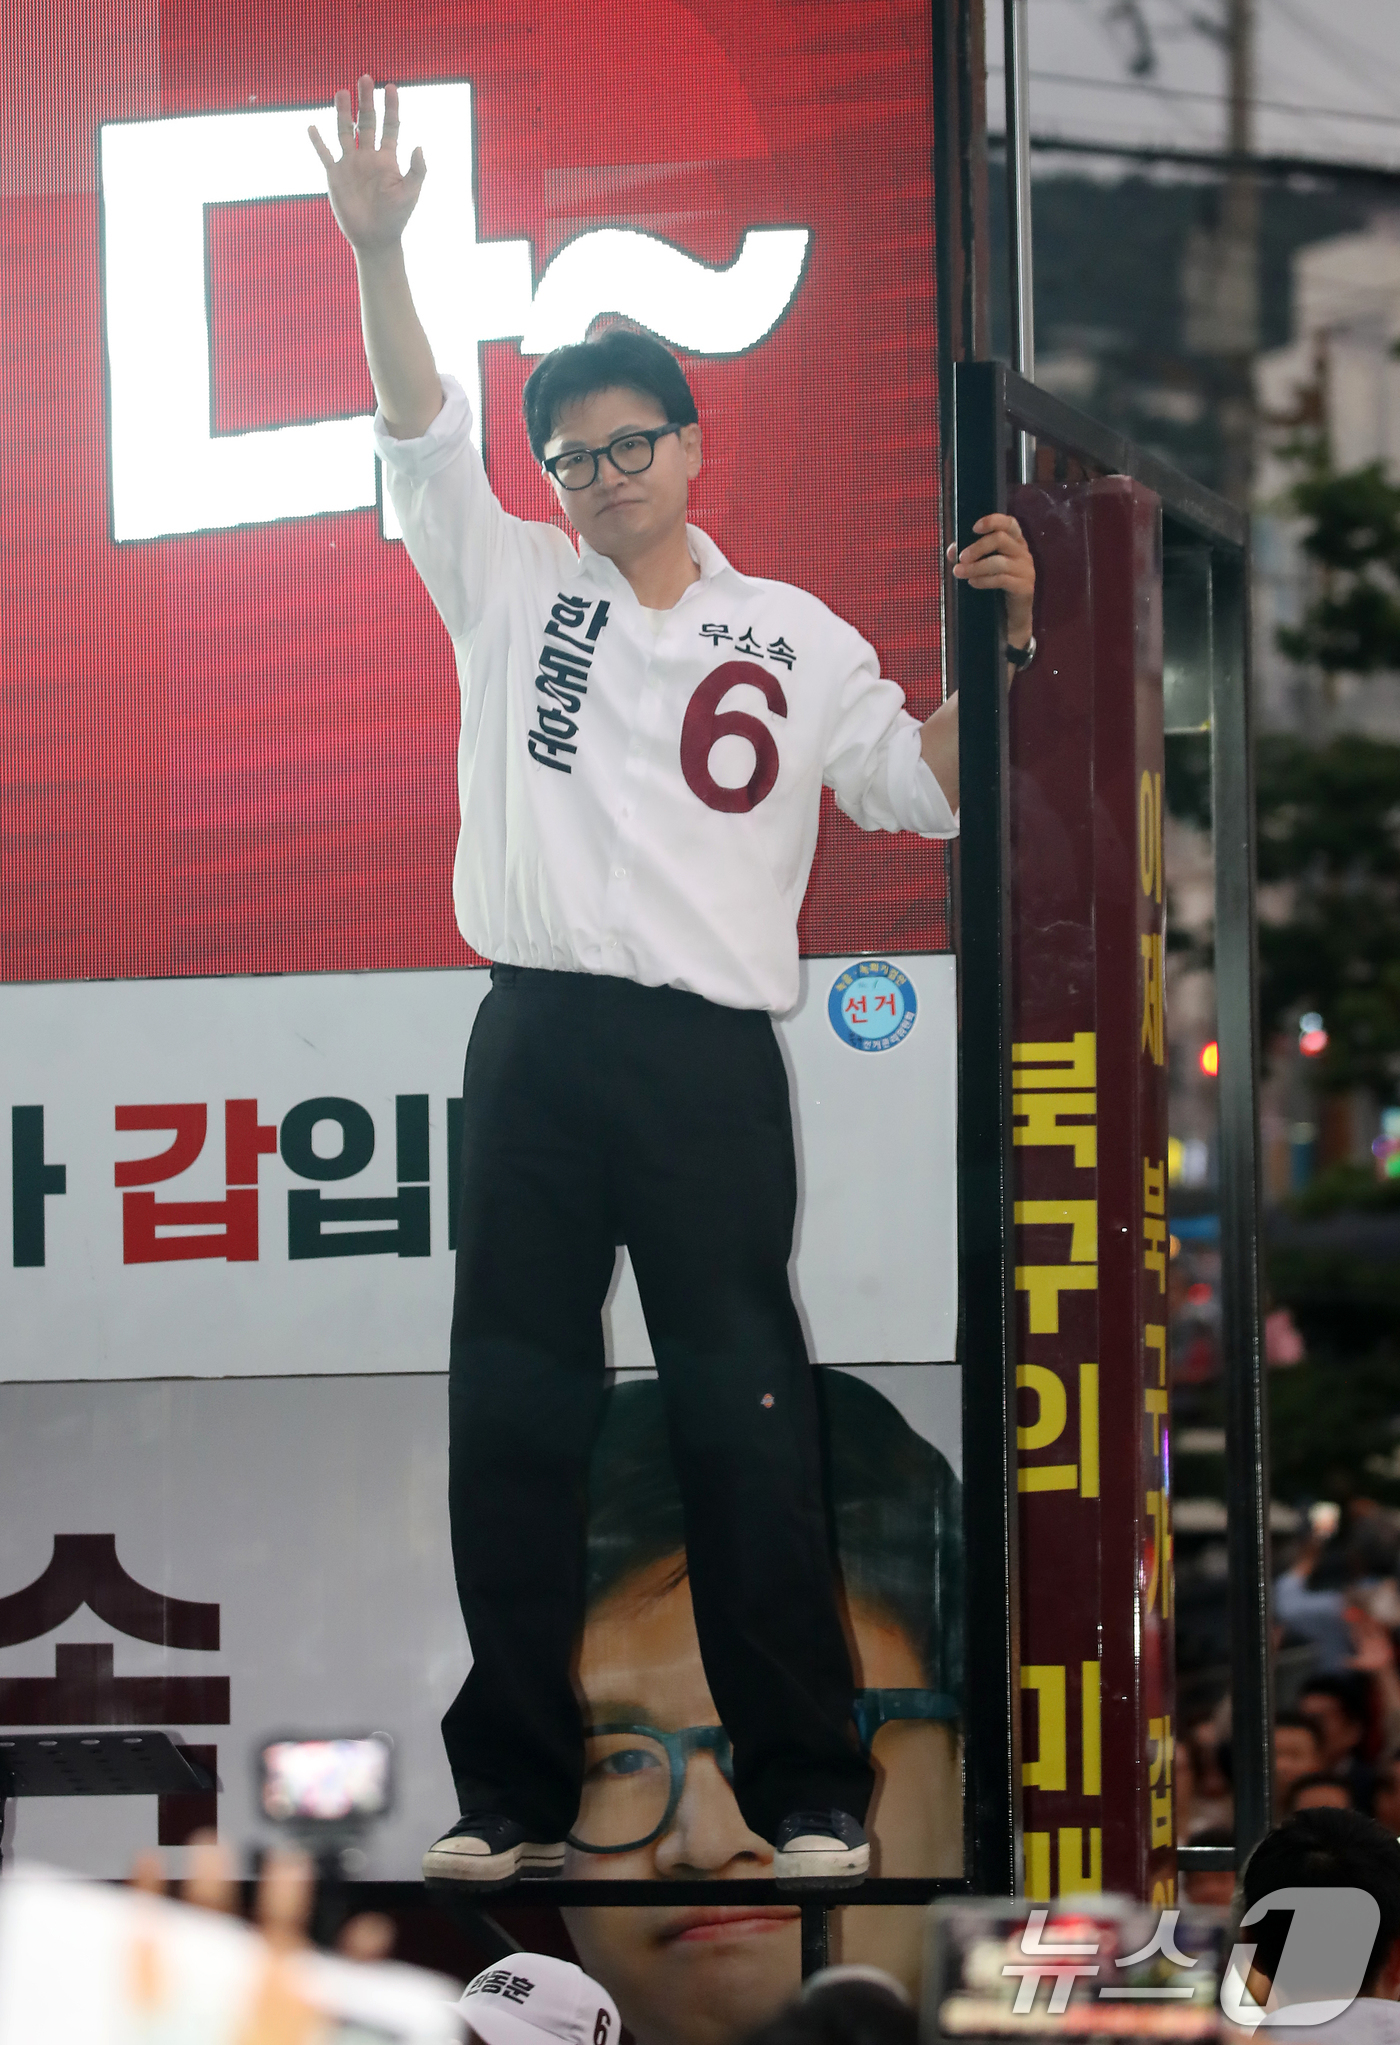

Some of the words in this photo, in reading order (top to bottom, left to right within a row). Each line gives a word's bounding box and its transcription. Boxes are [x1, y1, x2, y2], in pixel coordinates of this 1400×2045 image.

[527, 592, 611, 775] 한동훈
[698, 622, 798, 672] 무소속
[679, 660, 789, 814] 6
[1138, 769, 1164, 1067] 이제
[844, 992, 897, 1025] 선거
[114, 1093, 465, 1265] 갑입
[1011, 1031, 1100, 1499] 북구의
[1143, 1156, 1173, 1620] 북구가
[593, 2007, 611, 2045] 6
